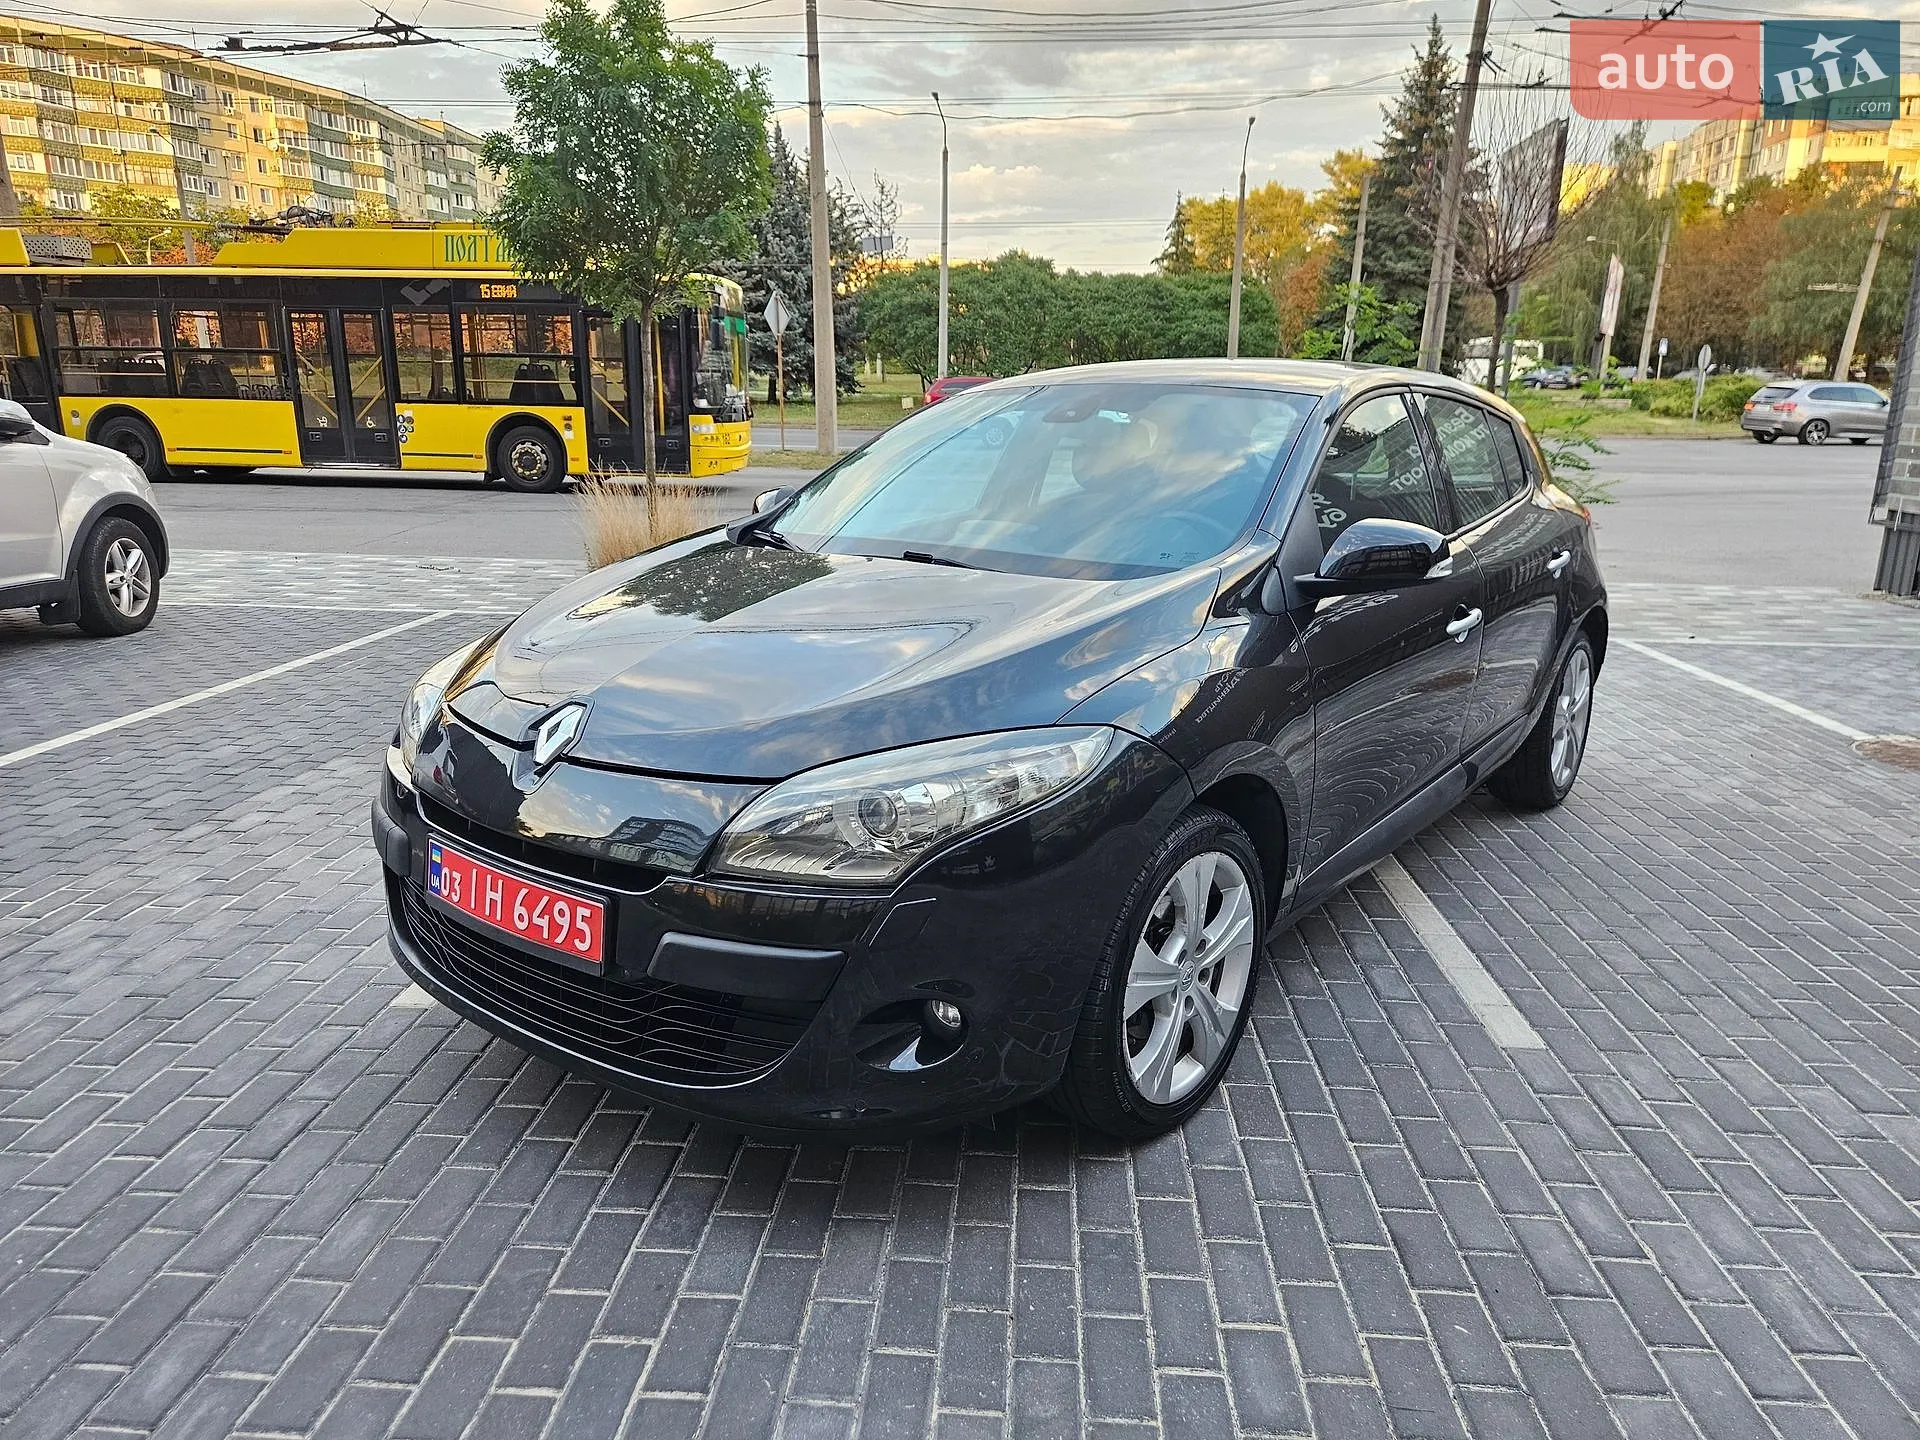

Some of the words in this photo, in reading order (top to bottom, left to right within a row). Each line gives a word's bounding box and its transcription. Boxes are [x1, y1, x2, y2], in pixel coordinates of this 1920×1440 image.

[431, 874, 441, 890] UA
[441, 867, 463, 903] 03
[513, 888, 593, 951] 6495
